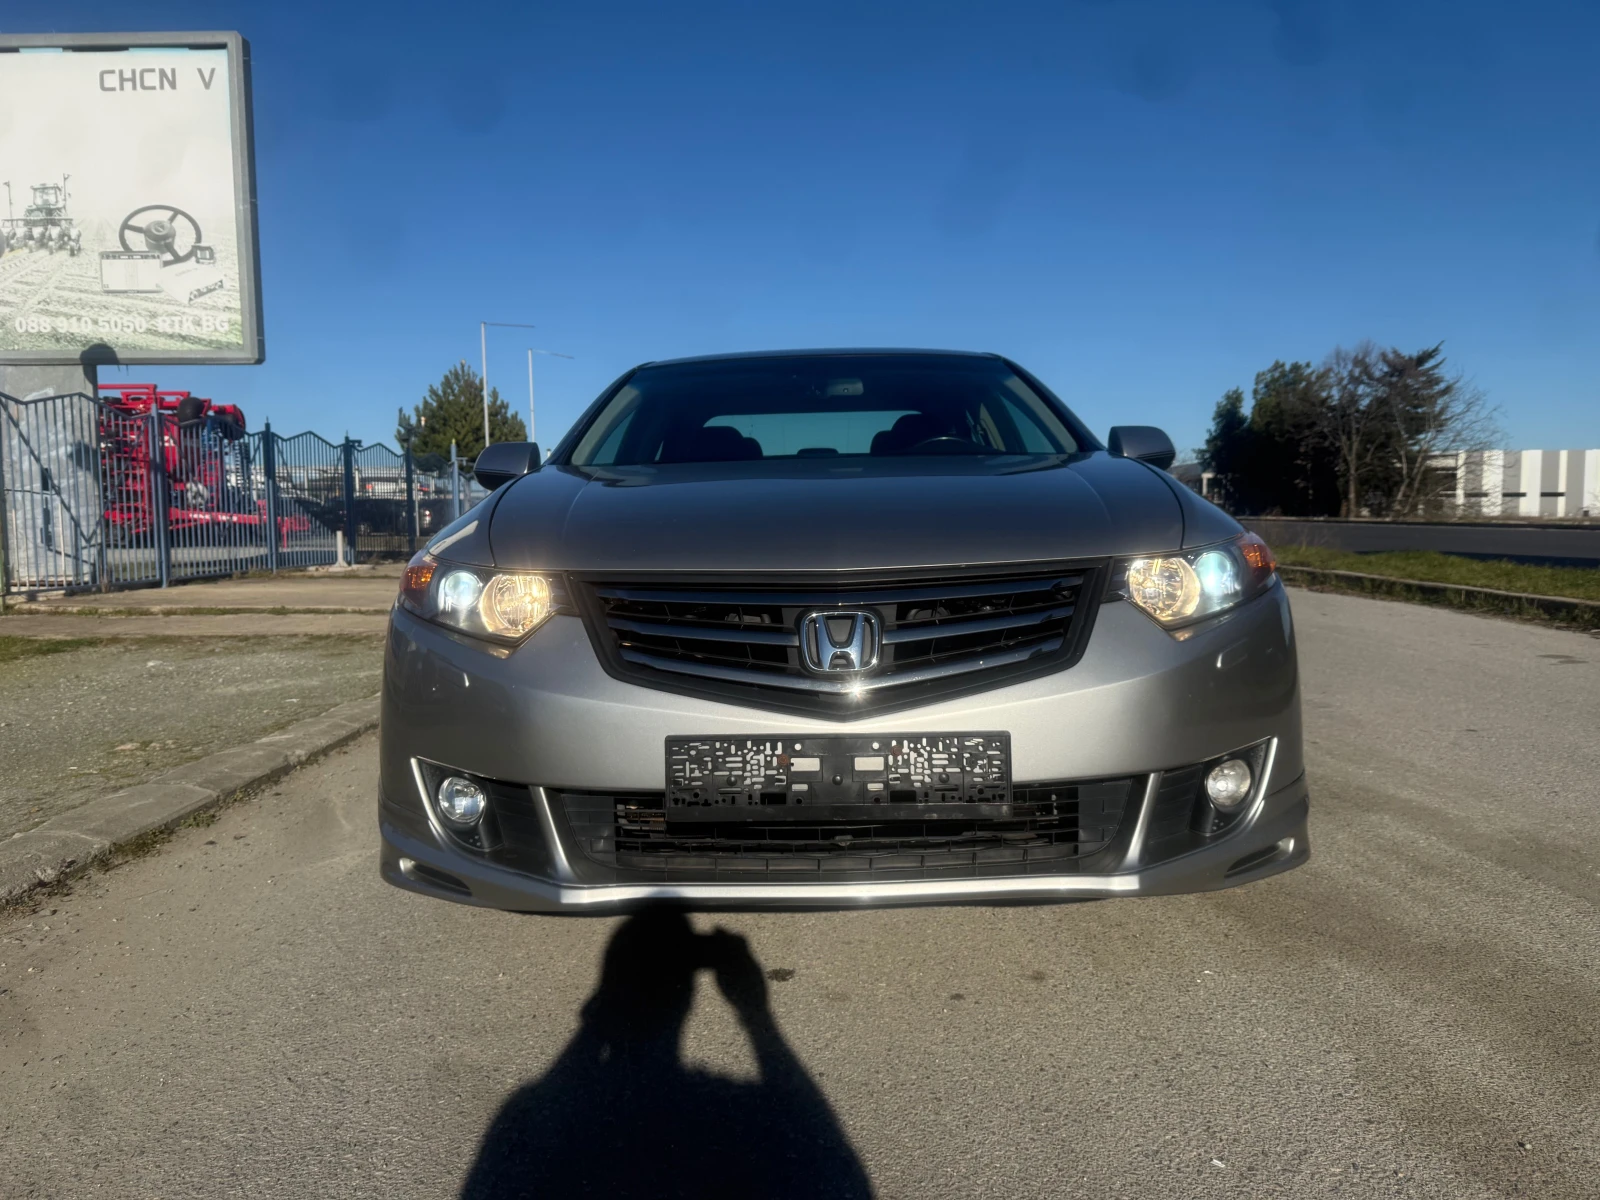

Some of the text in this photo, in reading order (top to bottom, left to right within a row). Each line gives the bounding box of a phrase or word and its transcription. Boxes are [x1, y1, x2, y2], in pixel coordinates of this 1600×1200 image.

[99, 68, 177, 92] CHCN
[16, 317, 50, 333] 088
[57, 317, 92, 333] 910
[99, 317, 146, 333] 5050
